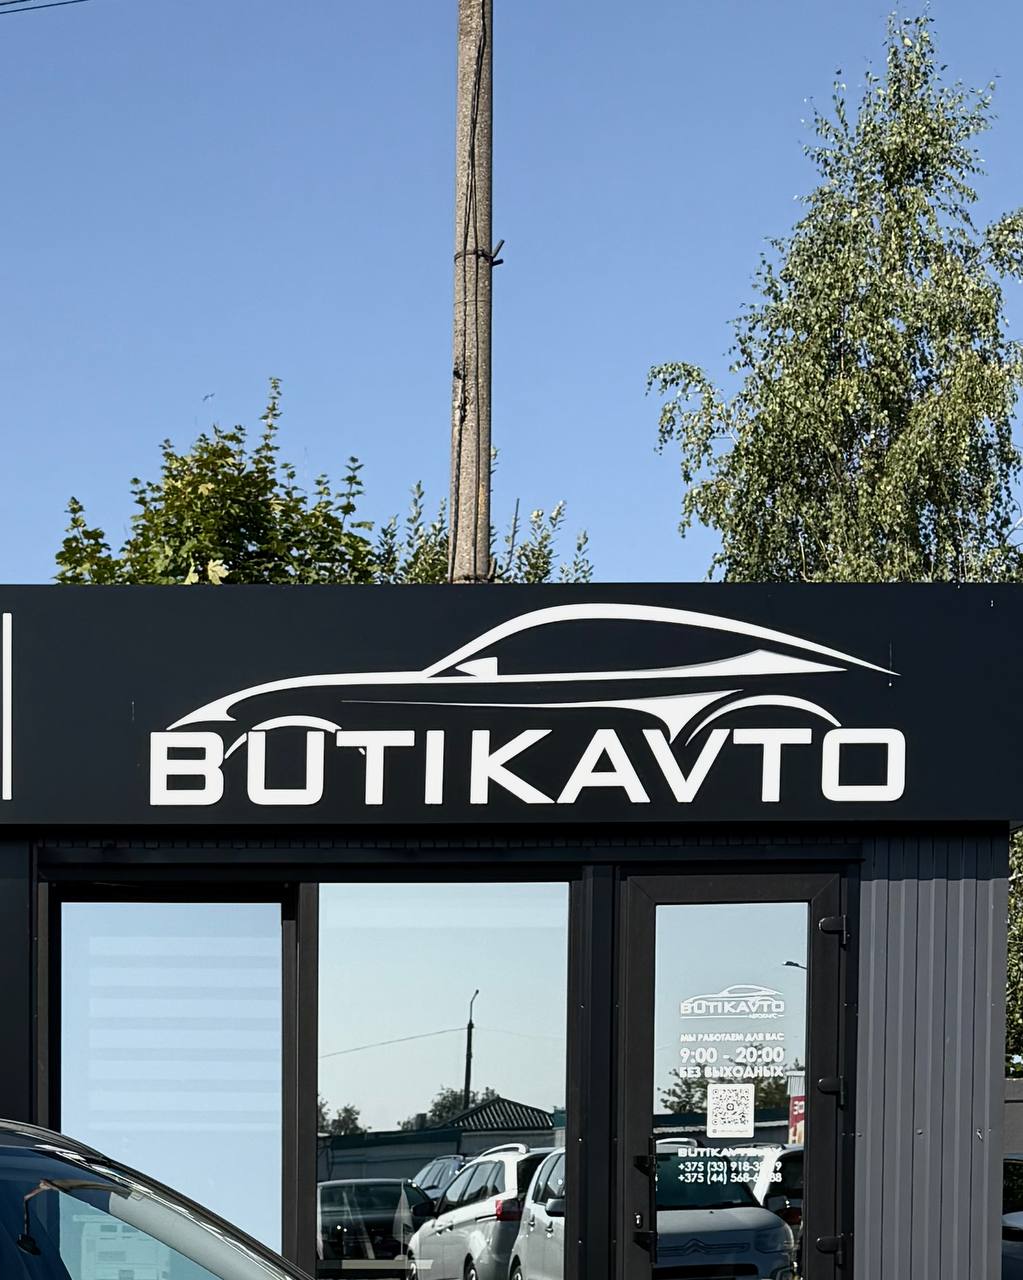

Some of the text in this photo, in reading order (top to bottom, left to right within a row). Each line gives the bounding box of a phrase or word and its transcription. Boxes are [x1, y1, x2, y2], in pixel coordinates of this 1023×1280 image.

[150, 728, 906, 806] BUTIKAVTO
[680, 1000, 785, 1014] BUTIKAVTO
[680, 1047, 718, 1064] 9:00
[735, 1046, 784, 1063] 20:00
[679, 1065, 784, 1079] БЕЗ ВЫХОДНЫХ
[678, 1161, 705, 1172] +375
[707, 1161, 727, 1174] (33)
[678, 1173, 705, 1183] +375
[707, 1172, 727, 1184] (44)
